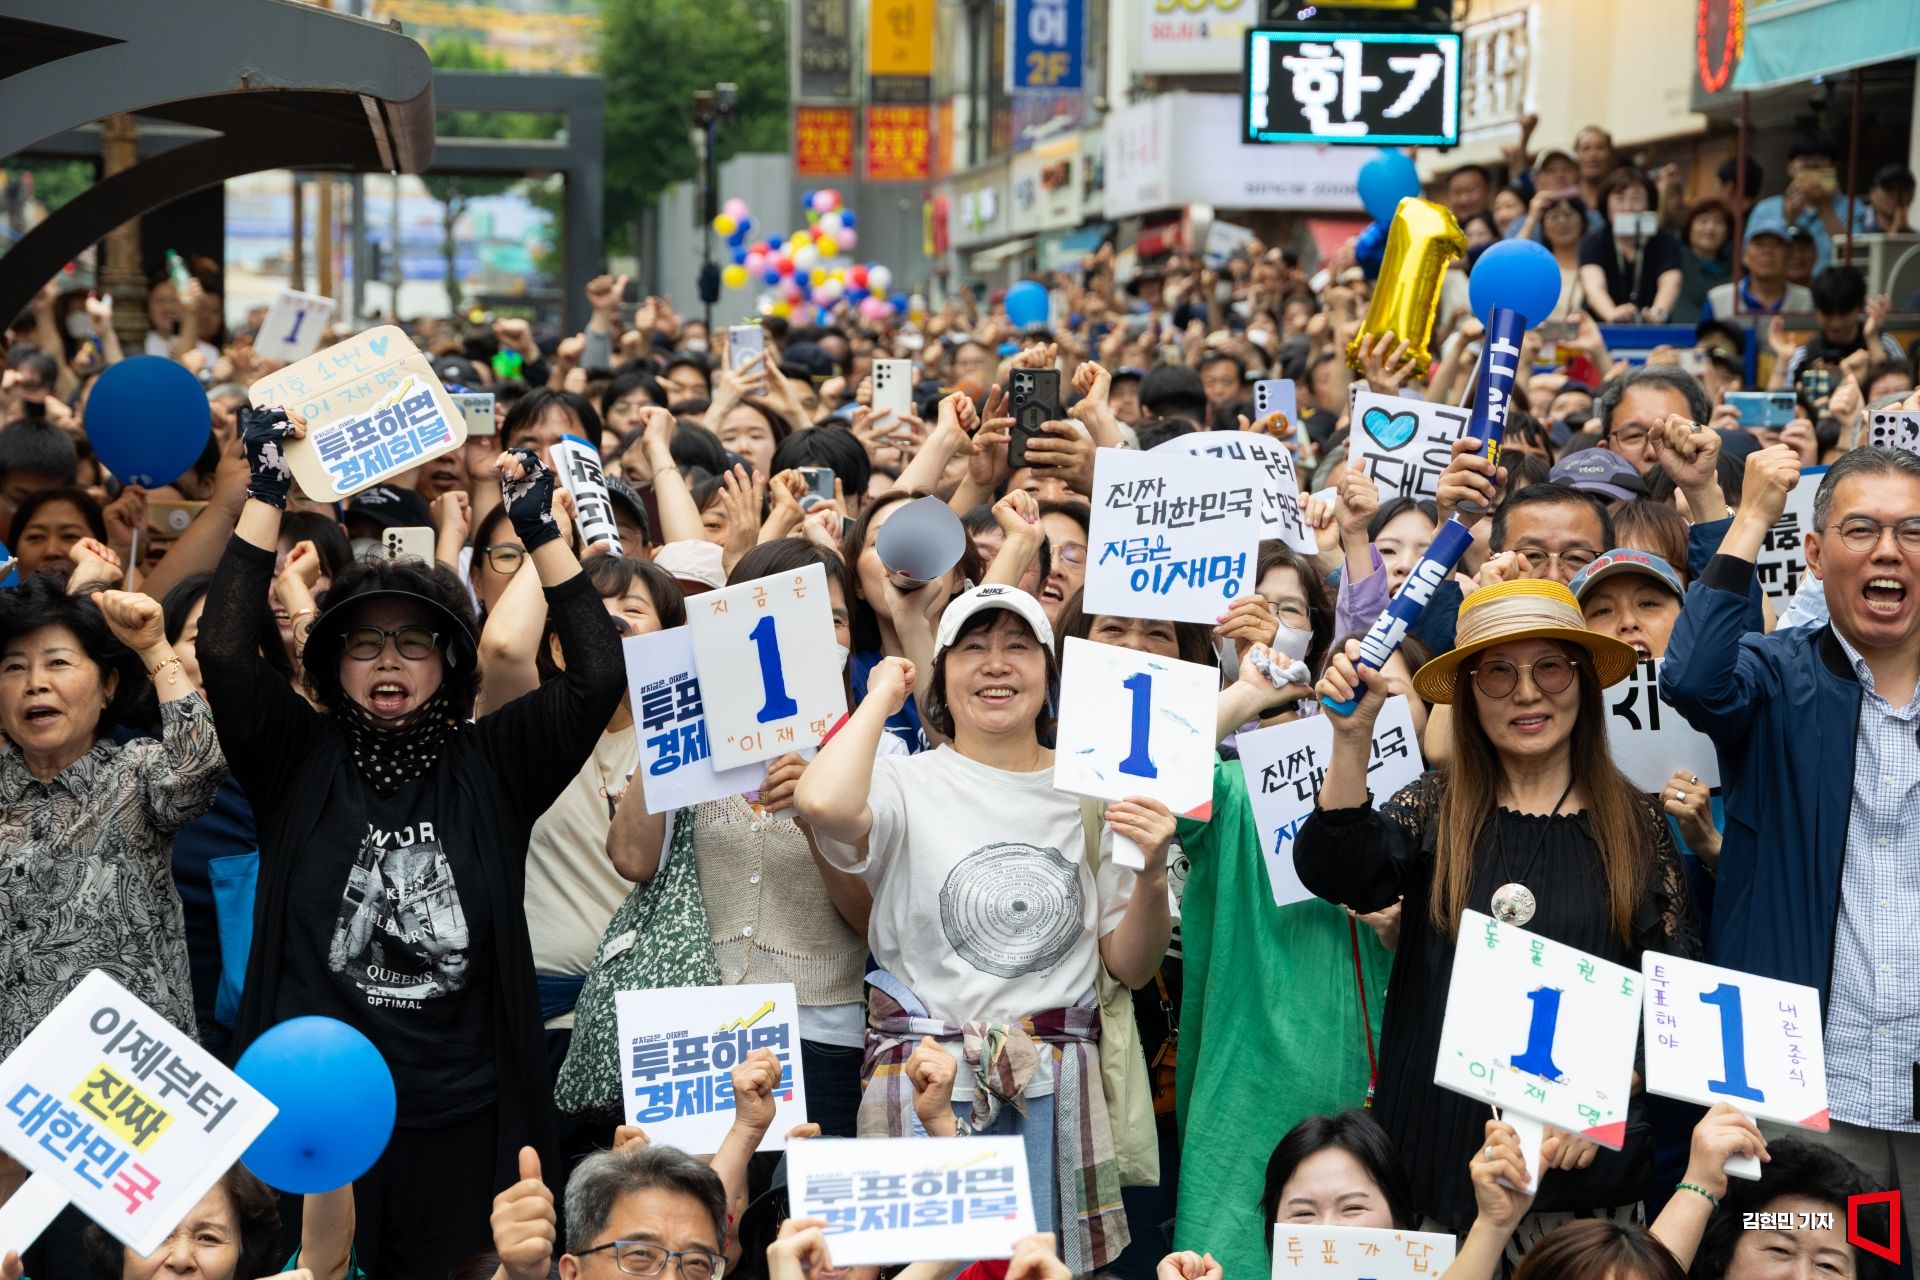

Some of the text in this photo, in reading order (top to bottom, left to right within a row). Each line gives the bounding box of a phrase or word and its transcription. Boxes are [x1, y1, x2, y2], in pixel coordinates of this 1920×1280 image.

[1026, 51, 1071, 86] 2F
[316, 390, 439, 462] 투표하면
[329, 416, 449, 490] 경제회복
[1105, 477, 1166, 509] 진짜
[1136, 488, 1253, 528] 대한민국
[1099, 534, 1171, 566] 지금은
[1130, 552, 1247, 599] 이재명
[640, 671, 689, 695] #지금은_이재명
[749, 615, 798, 724] 1
[1119, 673, 1157, 779] 1
[1261, 745, 1316, 794] 진짜
[366, 964, 433, 985] QUEENS
[367, 996, 423, 1010] OPTIMAL
[1510, 986, 1564, 1084] 1
[1699, 982, 1765, 1103] 1
[89, 1006, 238, 1134] 이제부터
[79, 1068, 168, 1147] 진짜
[5, 1083, 162, 1215] 대한민국
[804, 1166, 1015, 1204] 투표하면
[806, 1195, 1018, 1236] 경제회복
